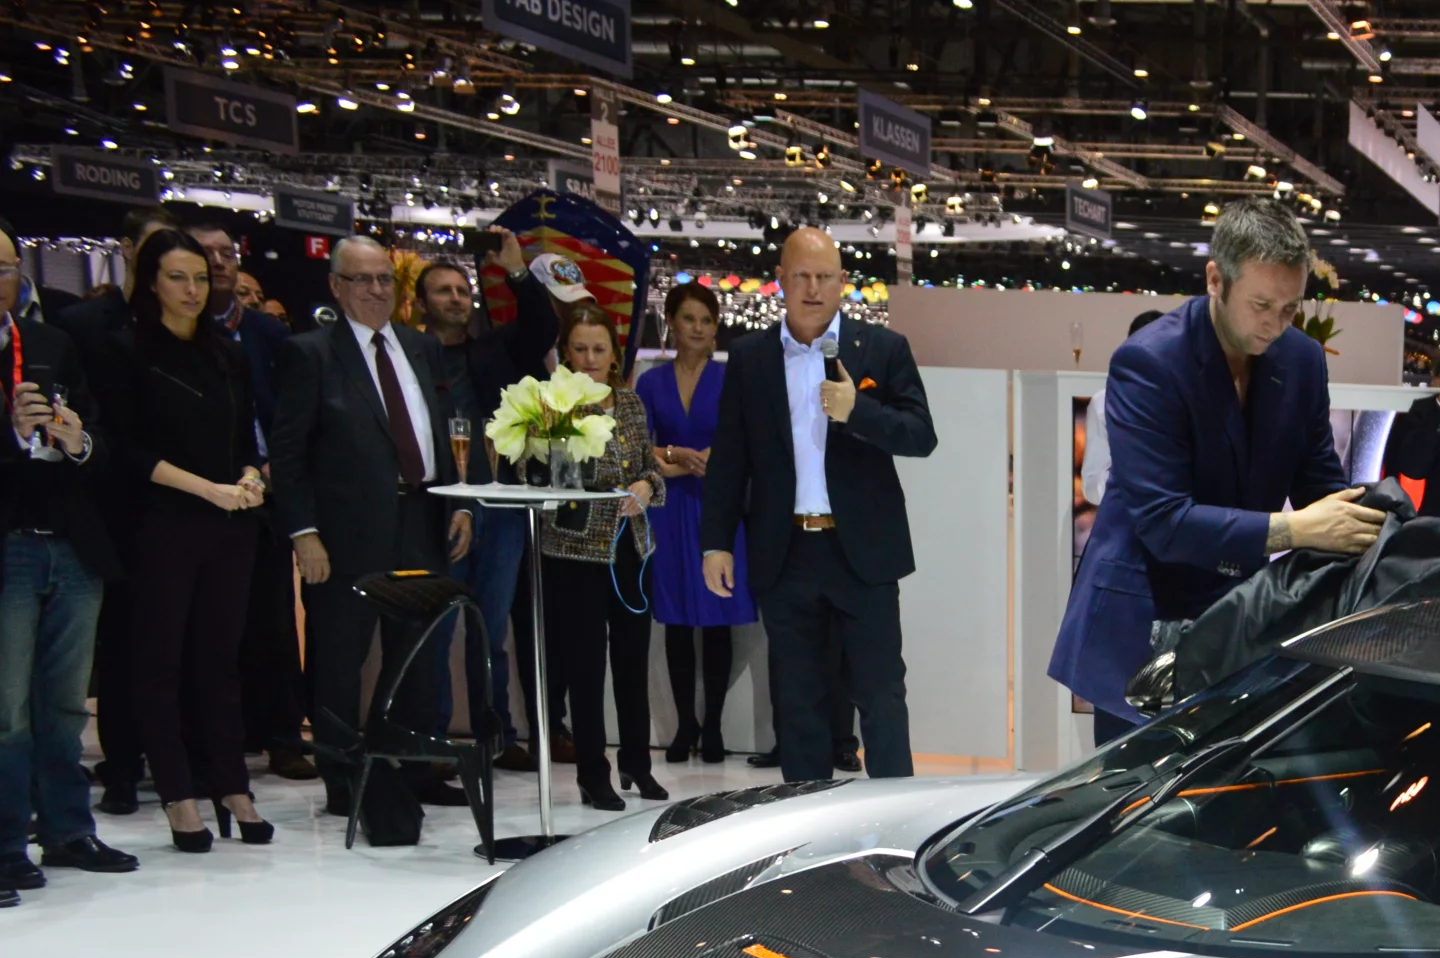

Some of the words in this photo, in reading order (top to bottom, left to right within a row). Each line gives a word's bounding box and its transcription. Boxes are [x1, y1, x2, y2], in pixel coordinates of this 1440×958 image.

[547, 0, 615, 44] DESIGN
[214, 96, 257, 127] TCS
[872, 113, 920, 153] KLASSEN
[75, 162, 141, 190] RODING
[594, 151, 618, 176] 2100
[310, 237, 324, 255] F
